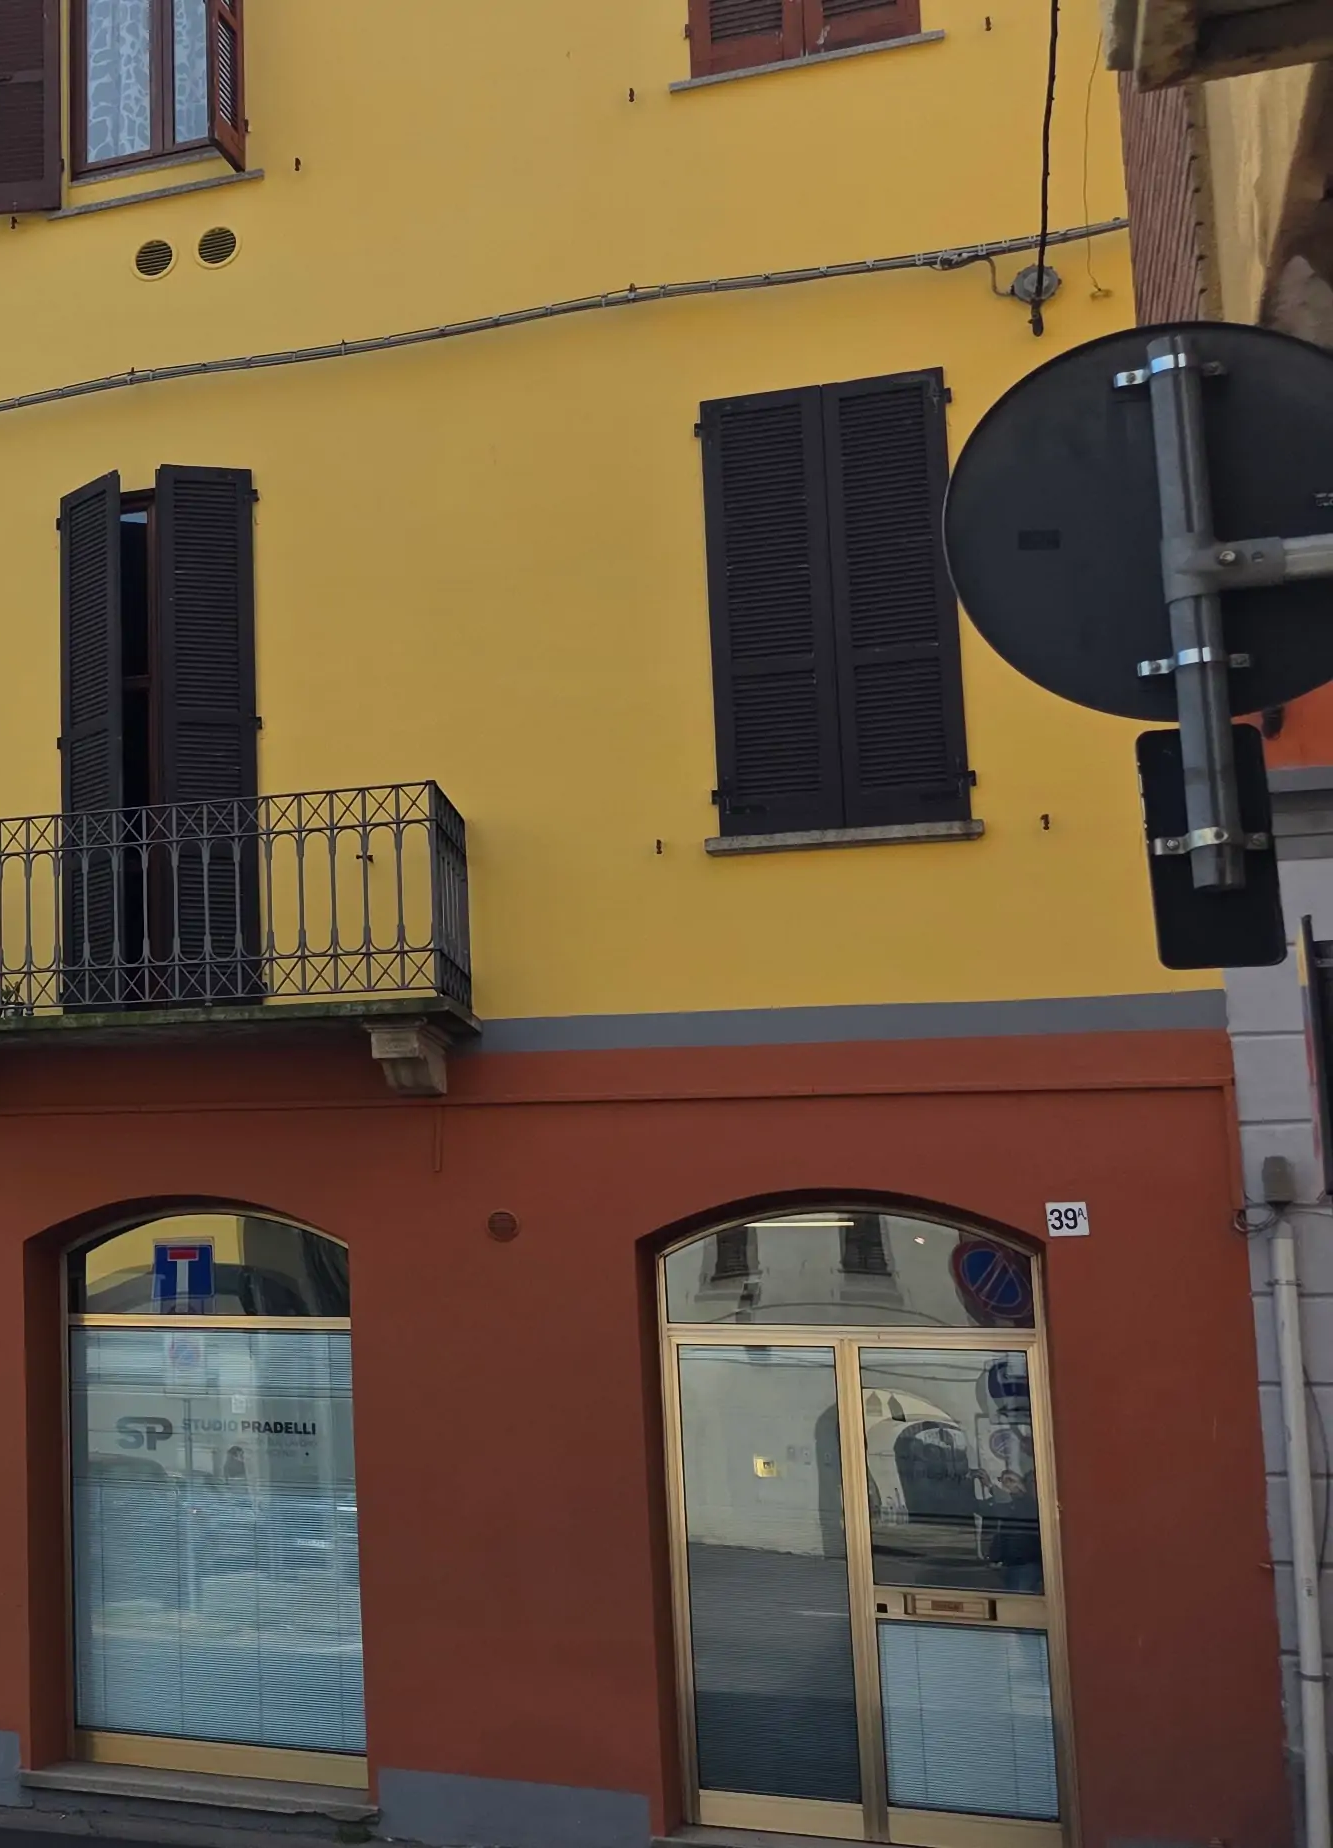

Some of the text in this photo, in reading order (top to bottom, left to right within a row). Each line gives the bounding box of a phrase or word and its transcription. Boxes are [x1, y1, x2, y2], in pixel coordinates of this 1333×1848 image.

[116, 1416, 173, 1450] SP
[182, 1419, 316, 1435] STUDIO PRADELLI
